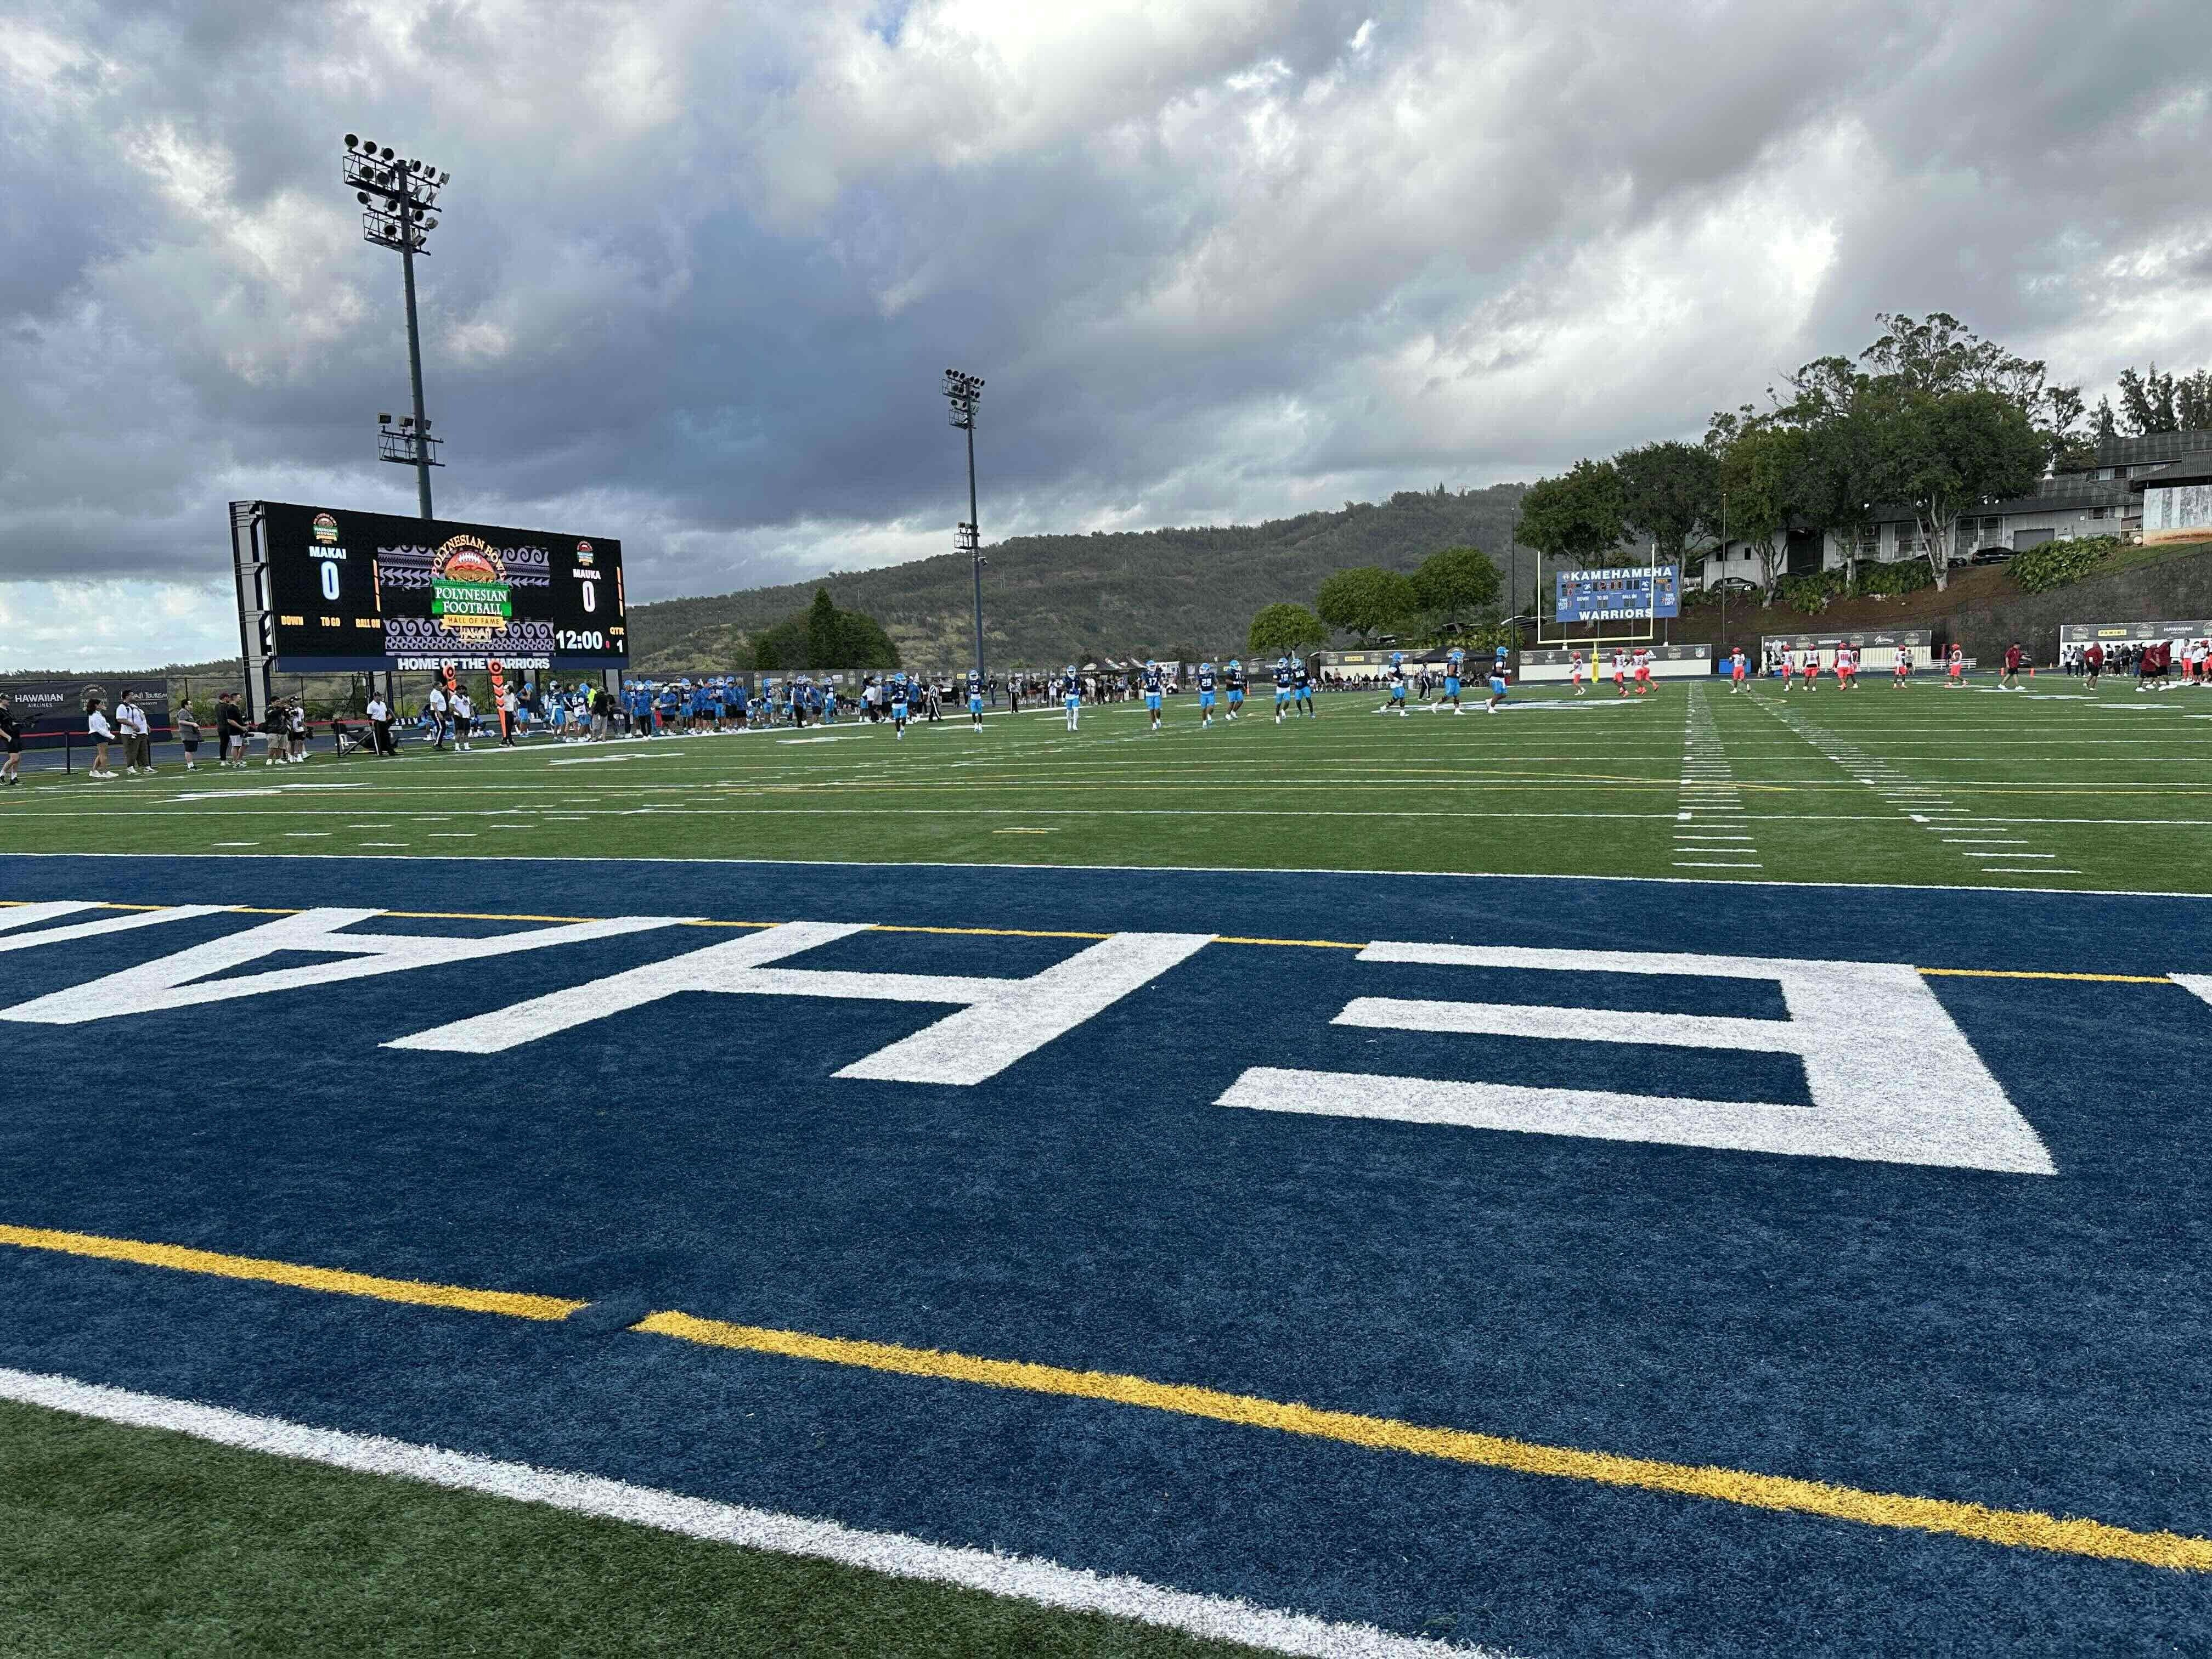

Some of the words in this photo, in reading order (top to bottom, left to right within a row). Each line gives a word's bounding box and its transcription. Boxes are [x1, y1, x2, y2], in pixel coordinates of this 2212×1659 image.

[309, 546, 346, 559] MAKAI
[431, 534, 485, 578] POLYNESIAN
[485, 545, 507, 580] BOWL
[321, 561, 340, 600] 0
[573, 569, 601, 580] MAUKA
[1571, 567, 1672, 581] KAMEHAMEHA
[435, 588, 508, 602] POLYNESIAN
[583, 580, 595, 612] 0
[443, 601, 503, 616] FOOTBALL
[1579, 608, 1652, 620] WARRIORS
[281, 616, 303, 625] DOWN
[320, 617, 329, 626] TO
[330, 617, 341, 627] GO
[356, 618, 371, 628] BALL
[371, 619, 381, 628] ON
[610, 627, 624, 635] QTR
[556, 630, 603, 650] 12:00
[617, 639, 623, 653] 1
[397, 658, 440, 670] HOME
[440, 658, 458, 669] OF
[459, 658, 486, 670] THE
[15, 693, 64, 702] HAWAIIAN
